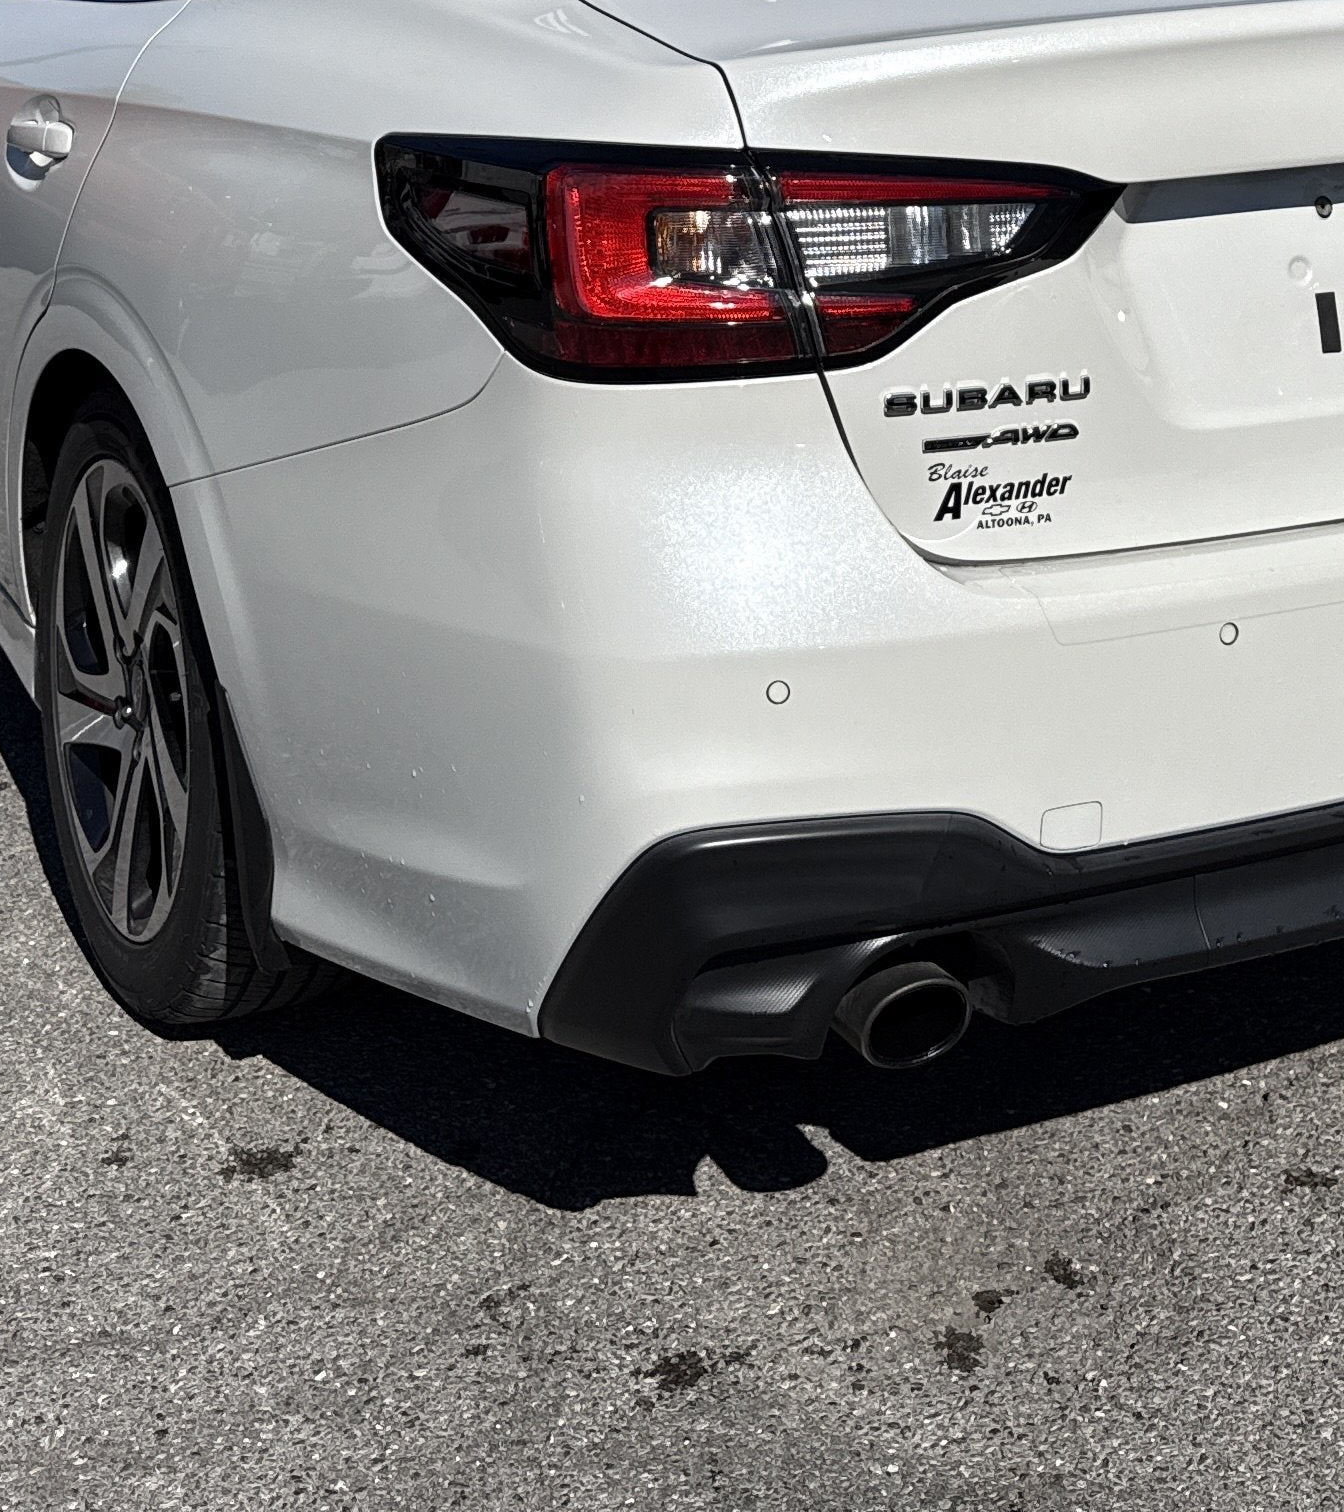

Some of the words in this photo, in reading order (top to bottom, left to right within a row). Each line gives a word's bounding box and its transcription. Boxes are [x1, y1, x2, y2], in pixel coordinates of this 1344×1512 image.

[882, 372, 1092, 418] SUBARU
[981, 421, 1080, 449] AWD
[927, 462, 990, 482] Blaise
[933, 472, 1073, 522] Alexander
[976, 516, 1035, 530] ALTOONA,
[1037, 513, 1053, 524] PA
